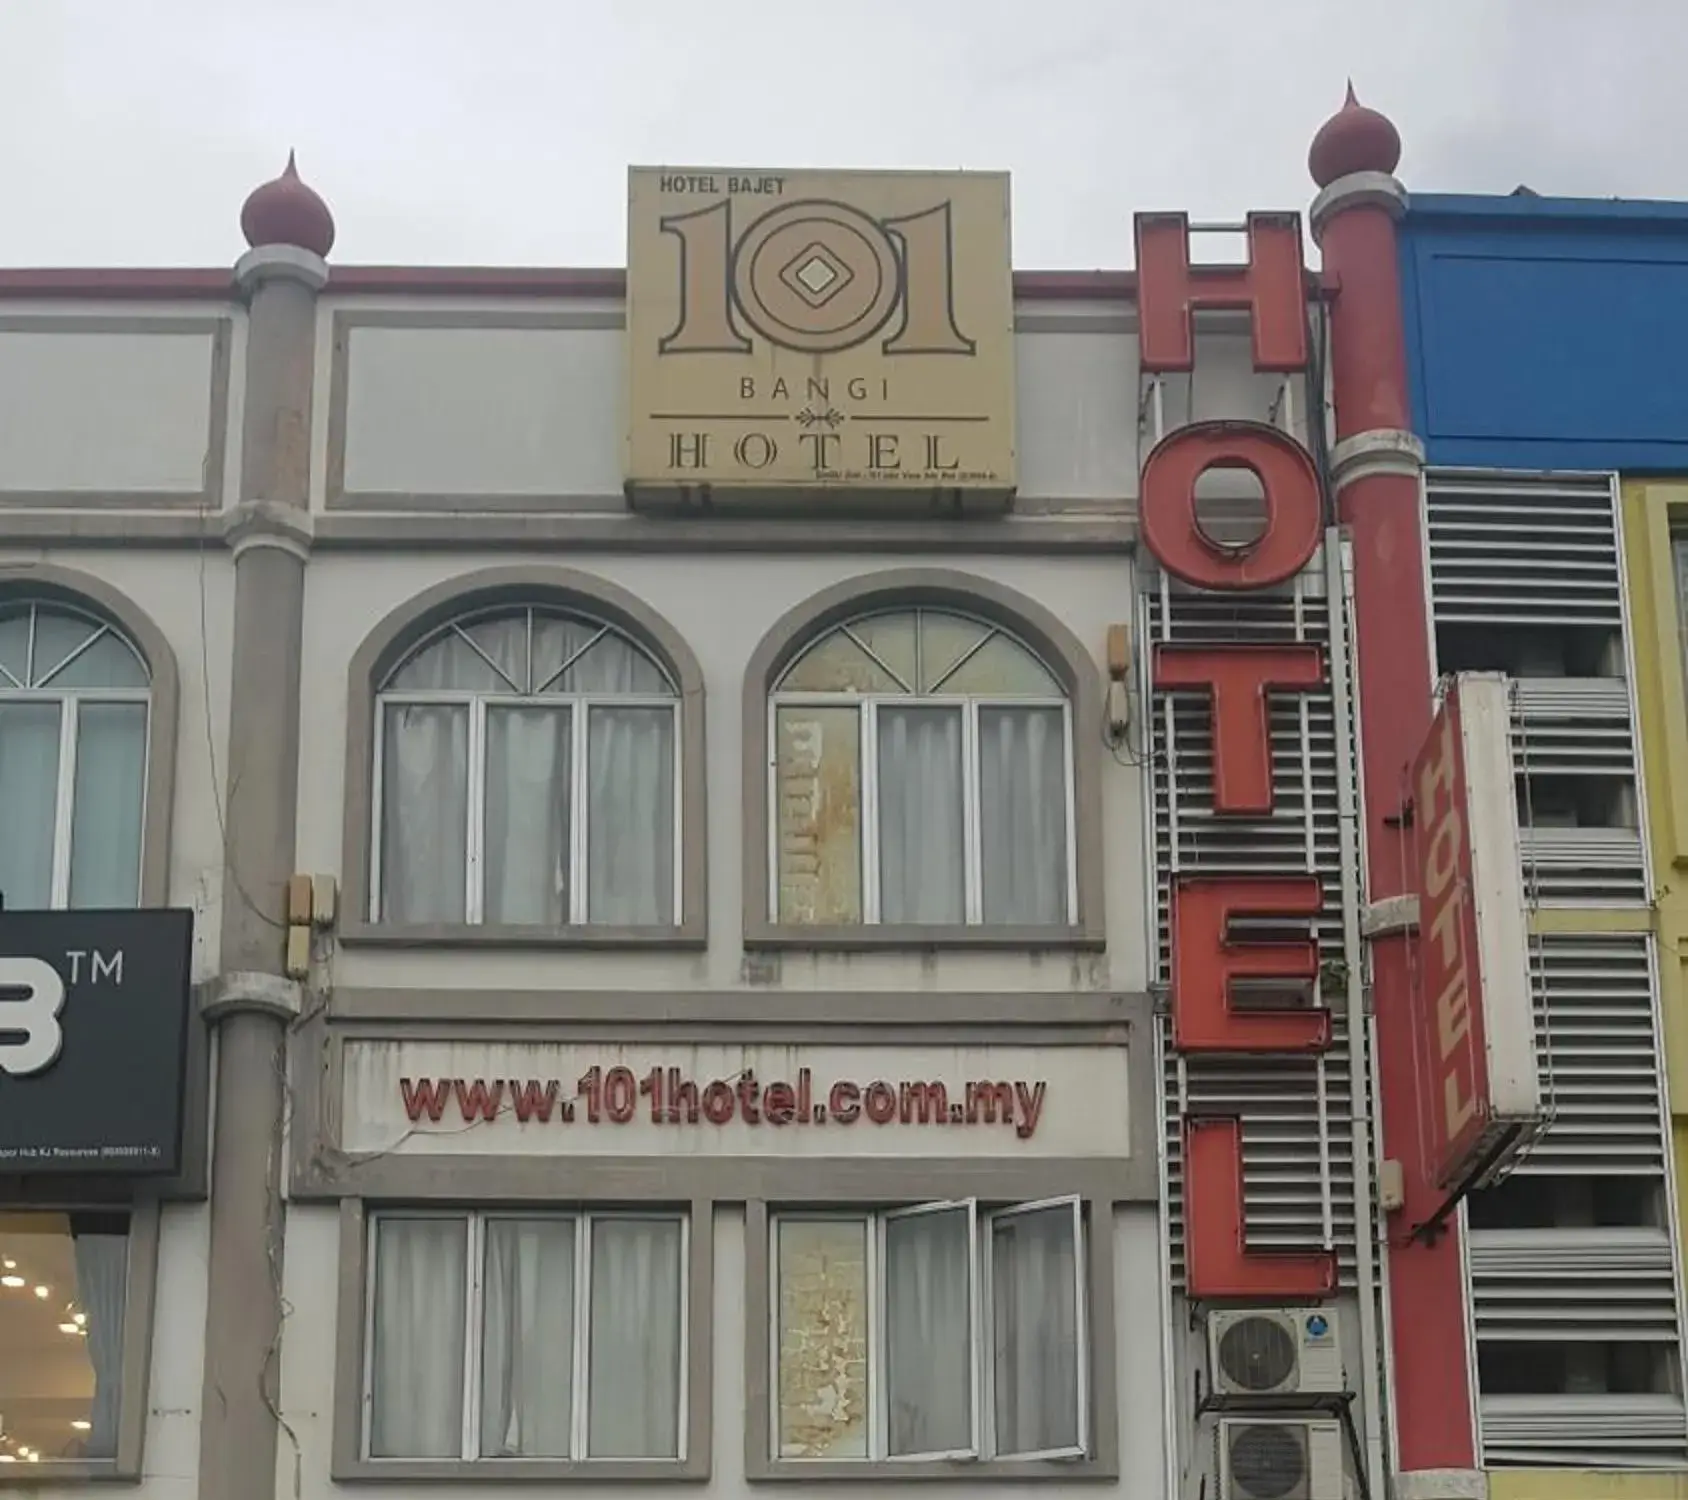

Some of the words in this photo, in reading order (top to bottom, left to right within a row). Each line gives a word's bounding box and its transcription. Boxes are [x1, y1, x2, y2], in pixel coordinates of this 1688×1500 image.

[660, 176, 719, 194] HOTEL
[728, 177, 786, 195] BAJET
[658, 198, 977, 357] 101
[740, 376, 888, 401] BANGI
[669, 433, 960, 471] HOTEL
[1134, 211, 1338, 1300] HOTEL
[1421, 719, 1476, 1139] HOTEL
[400, 1065, 1048, 1139] www.101hotel.com.my
